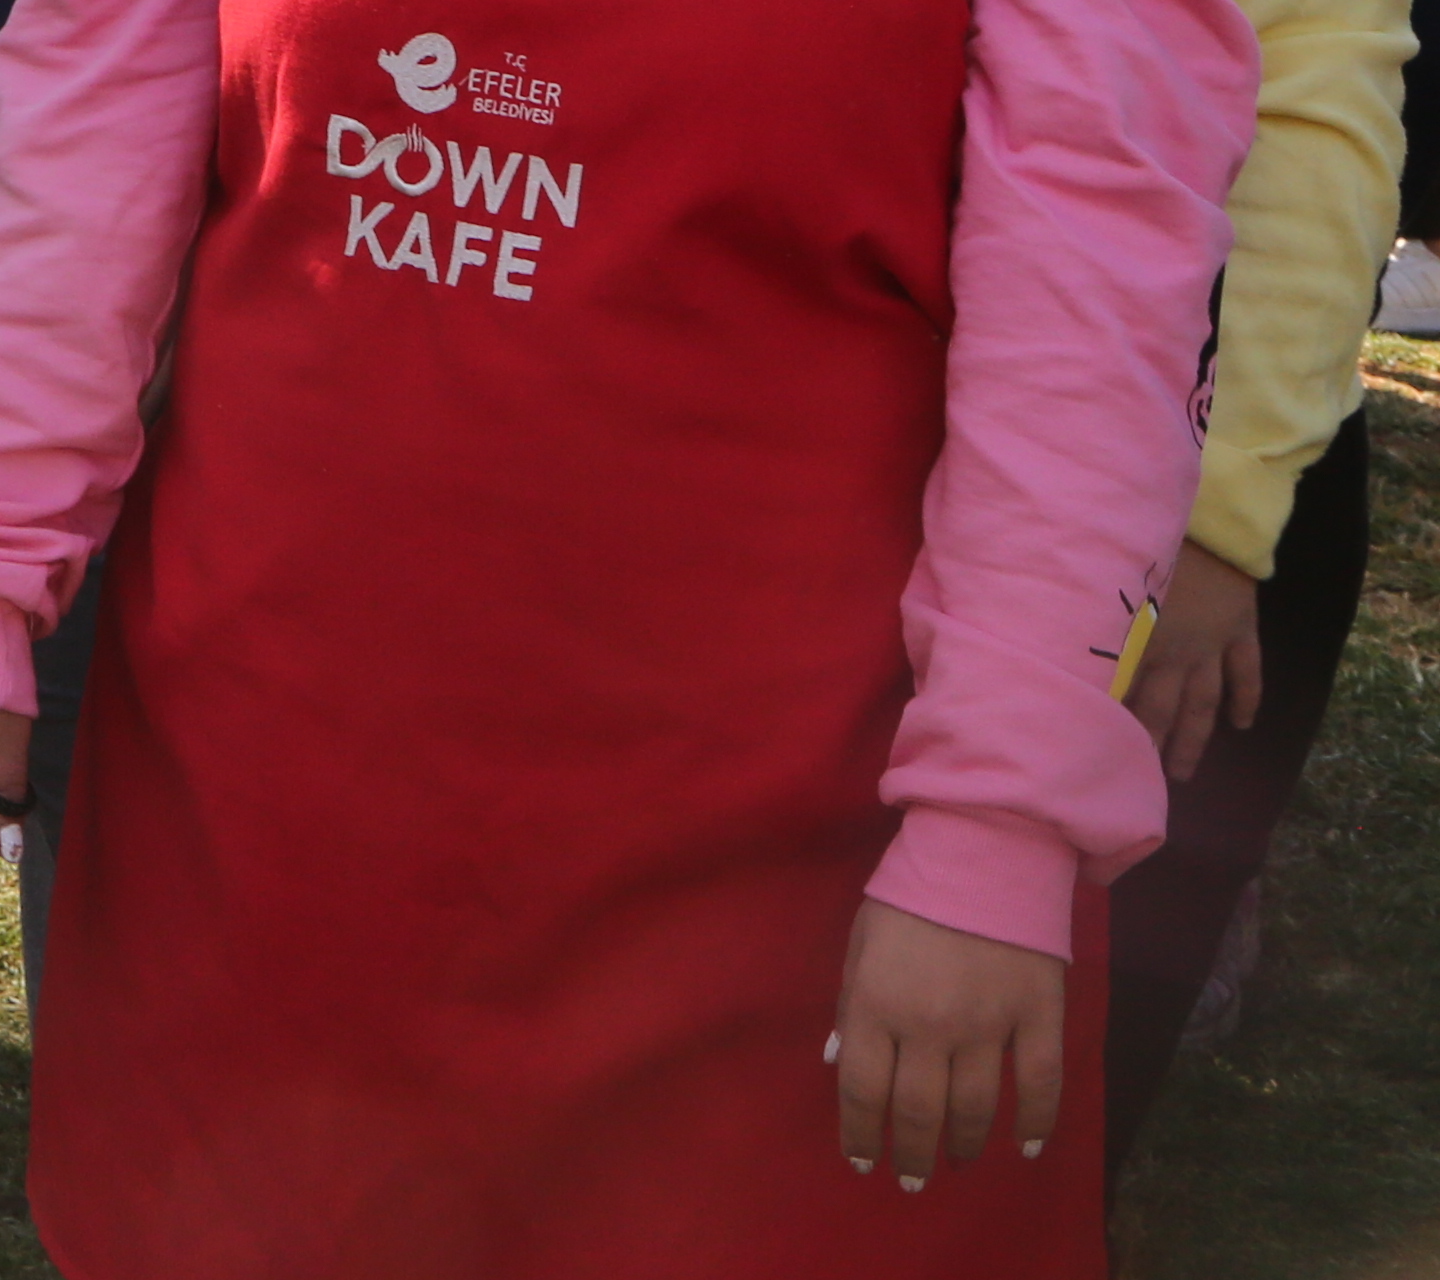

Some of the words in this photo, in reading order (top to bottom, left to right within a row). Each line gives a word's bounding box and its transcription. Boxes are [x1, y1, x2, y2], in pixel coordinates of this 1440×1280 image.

[467, 68, 562, 108] EFELER
[326, 114, 584, 228] DOWN
[342, 194, 543, 302] KAFE
